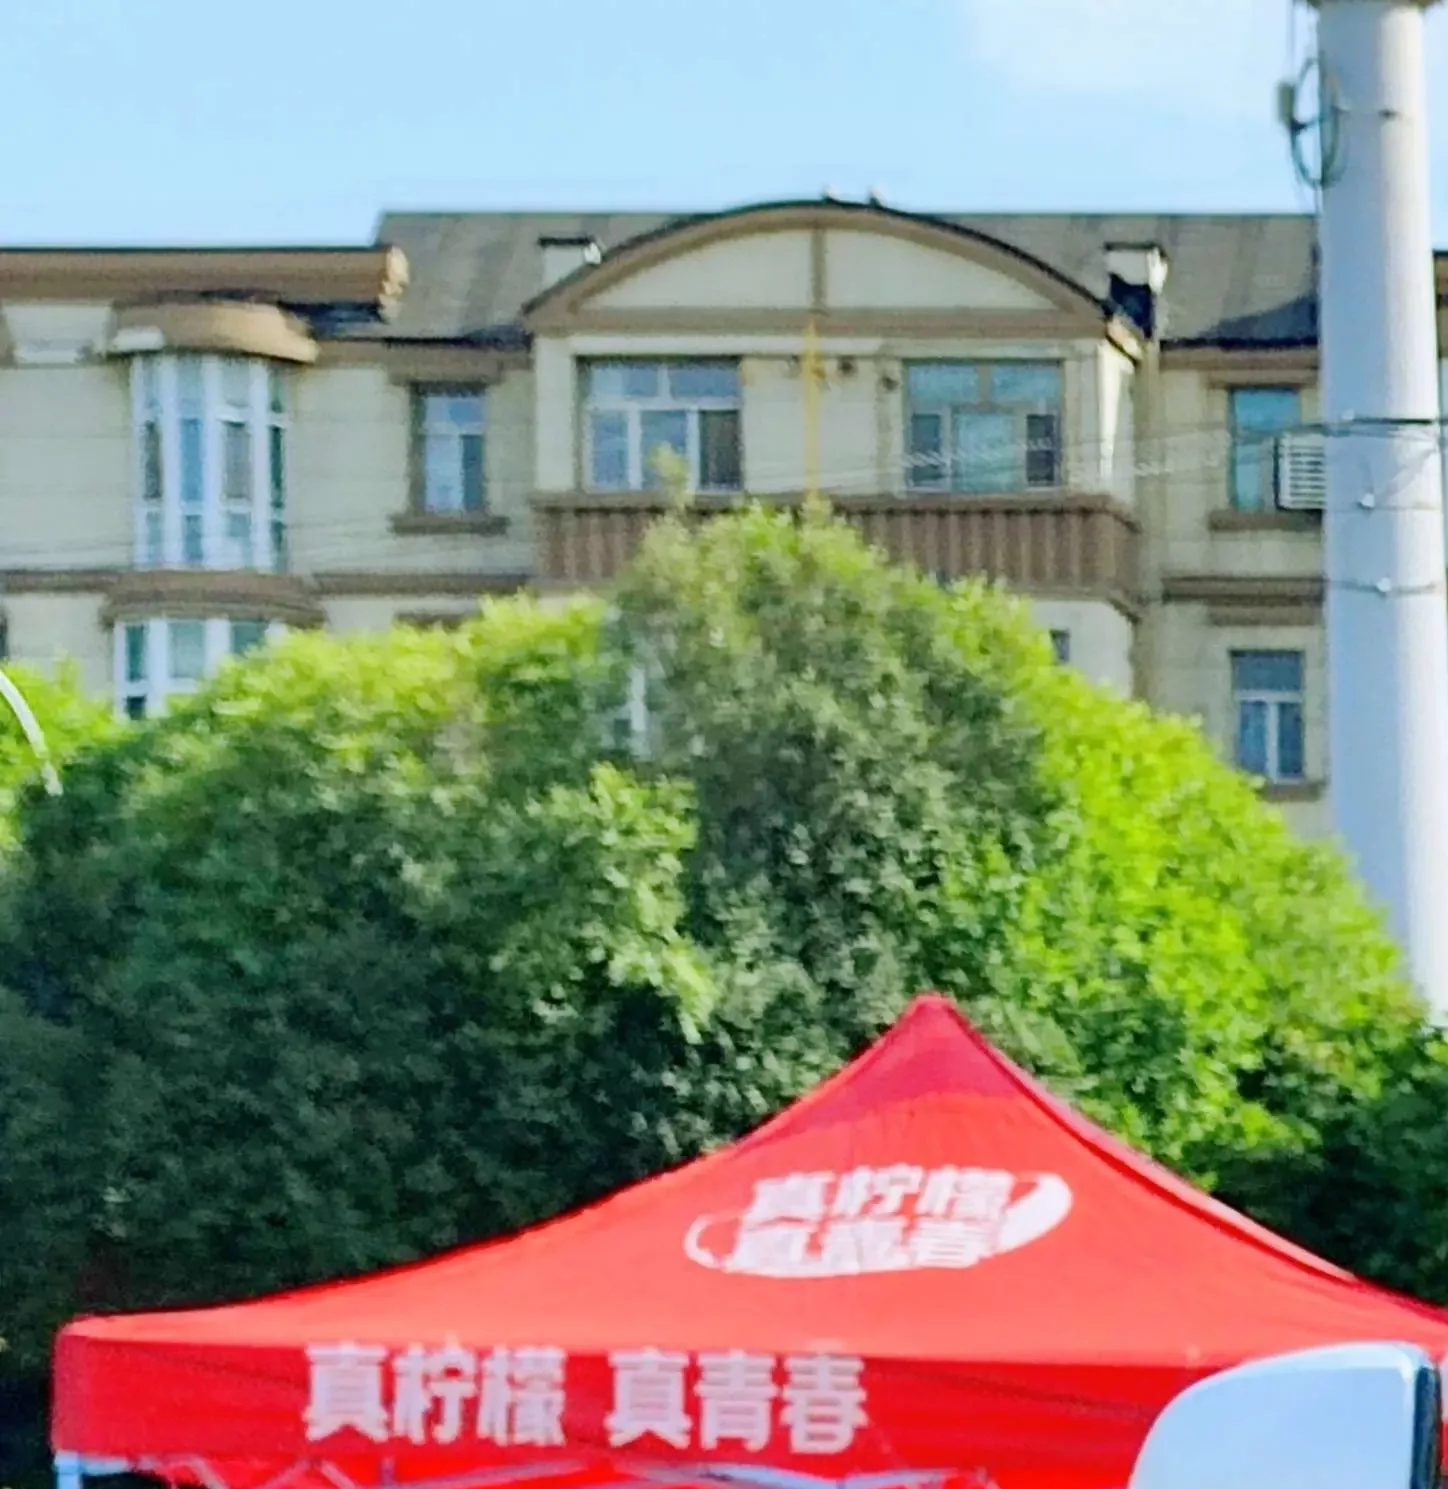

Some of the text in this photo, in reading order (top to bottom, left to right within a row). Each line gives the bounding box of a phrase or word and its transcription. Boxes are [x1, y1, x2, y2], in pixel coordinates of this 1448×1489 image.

[303, 1333, 868, 1454] 真柠檬 真青春
